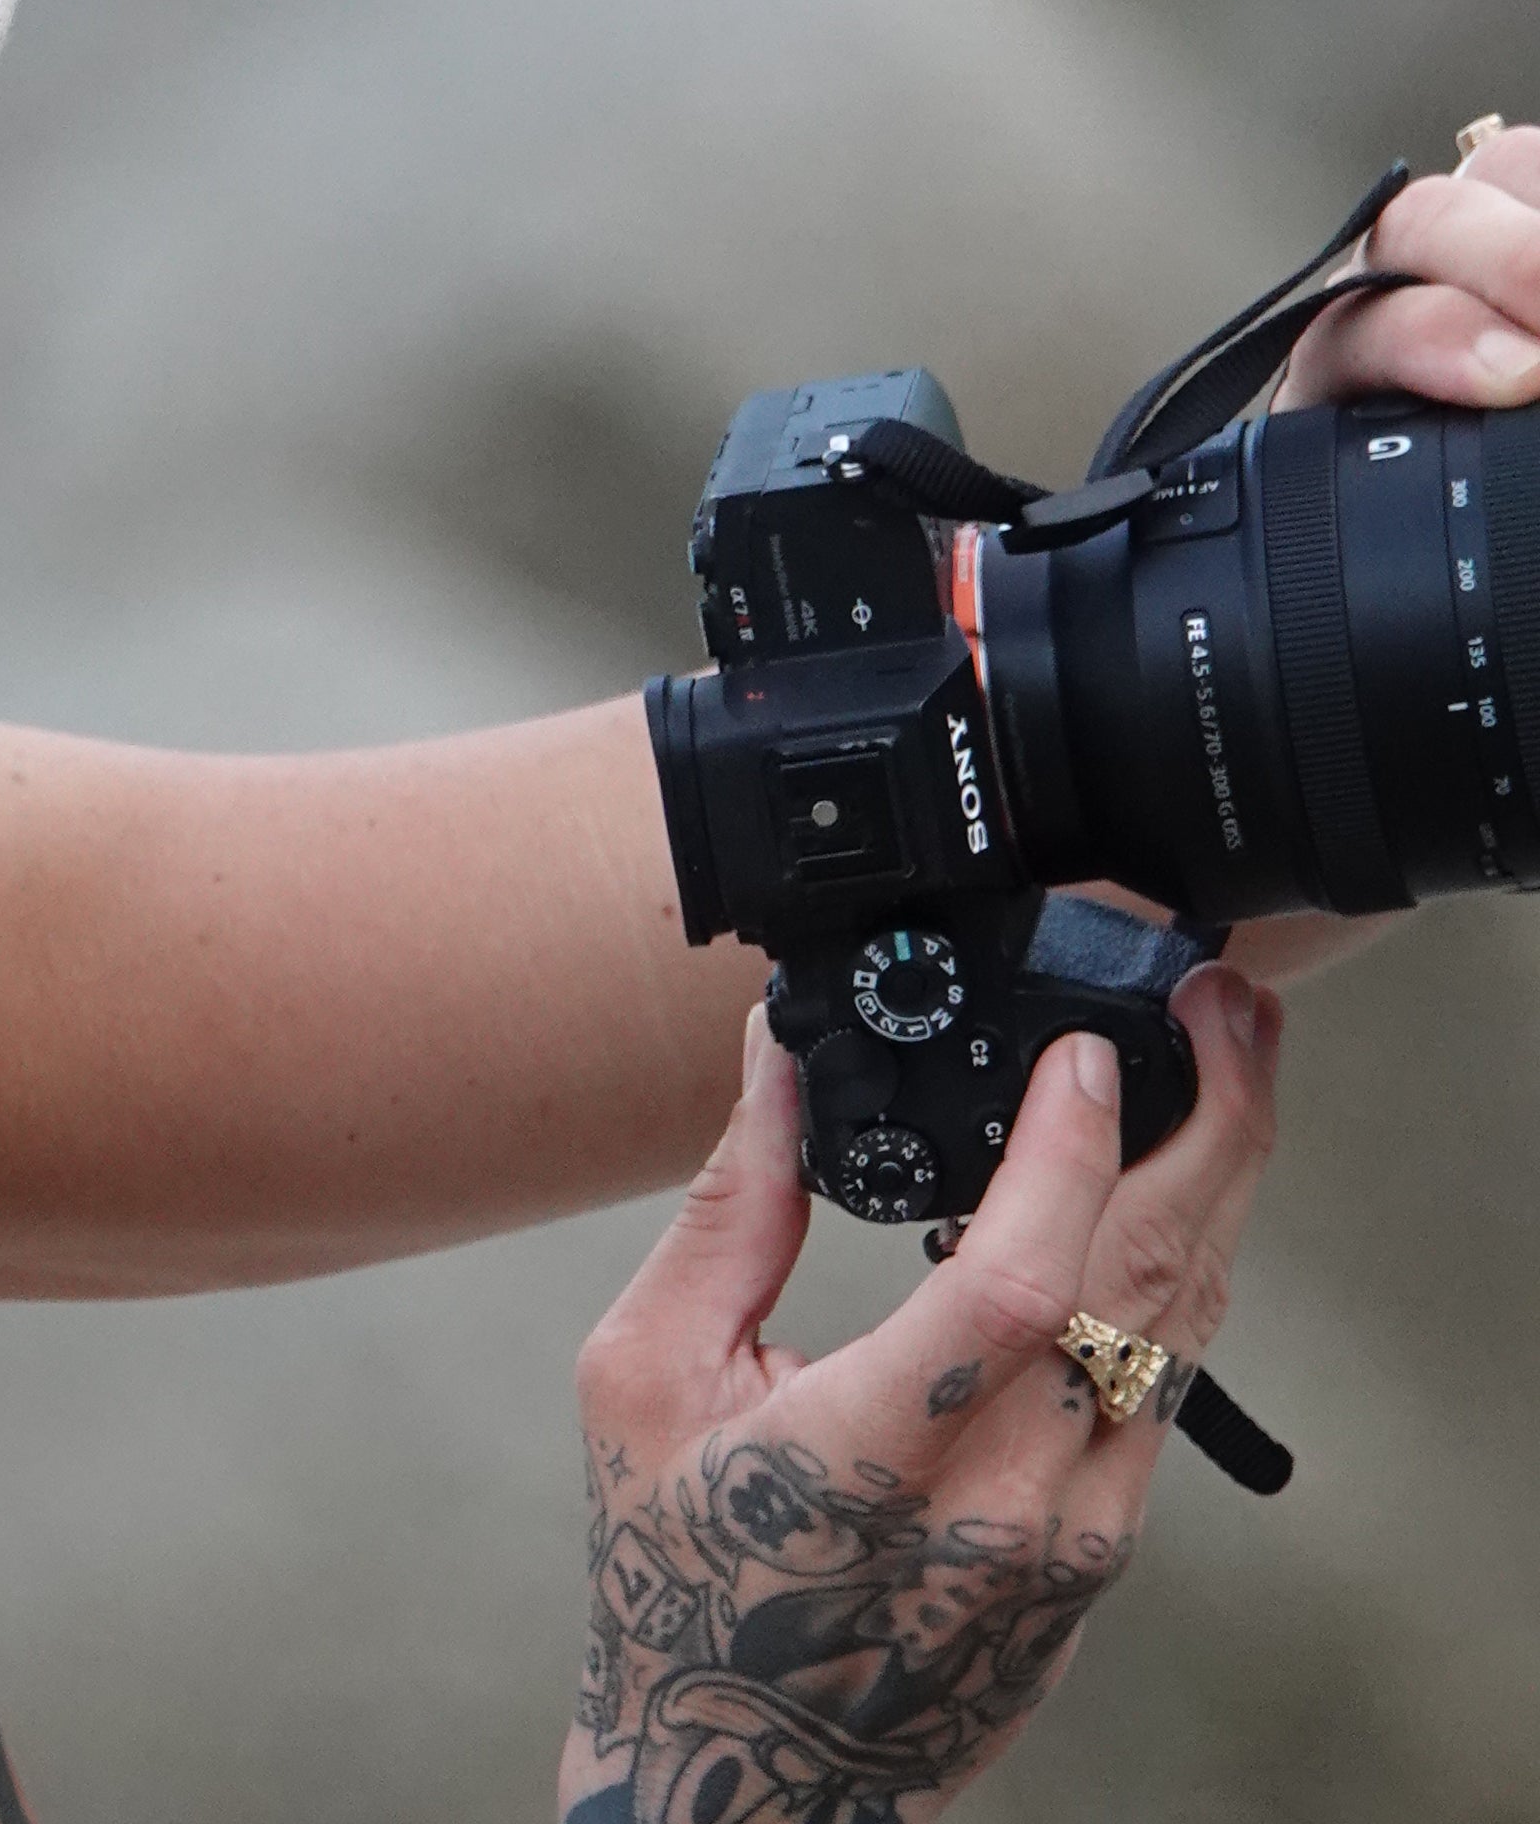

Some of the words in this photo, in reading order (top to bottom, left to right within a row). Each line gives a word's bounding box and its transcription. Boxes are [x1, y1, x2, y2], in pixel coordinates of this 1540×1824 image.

[1457, 559, 1476, 592] 200
[1186, 618, 1207, 643] FE
[1467, 636, 1487, 669] 135
[1478, 696, 1498, 729] 100
[947, 714, 989, 854] SONY
[922, 937, 939, 955] P
[939, 957, 956, 976] A
[862, 997, 878, 1016] 3
[948, 985, 964, 1005] S
[880, 1017, 899, 1033] 2
[930, 1008, 953, 1031] M
[970, 1039, 989, 1067] C2
[985, 1121, 1004, 1145] C1
